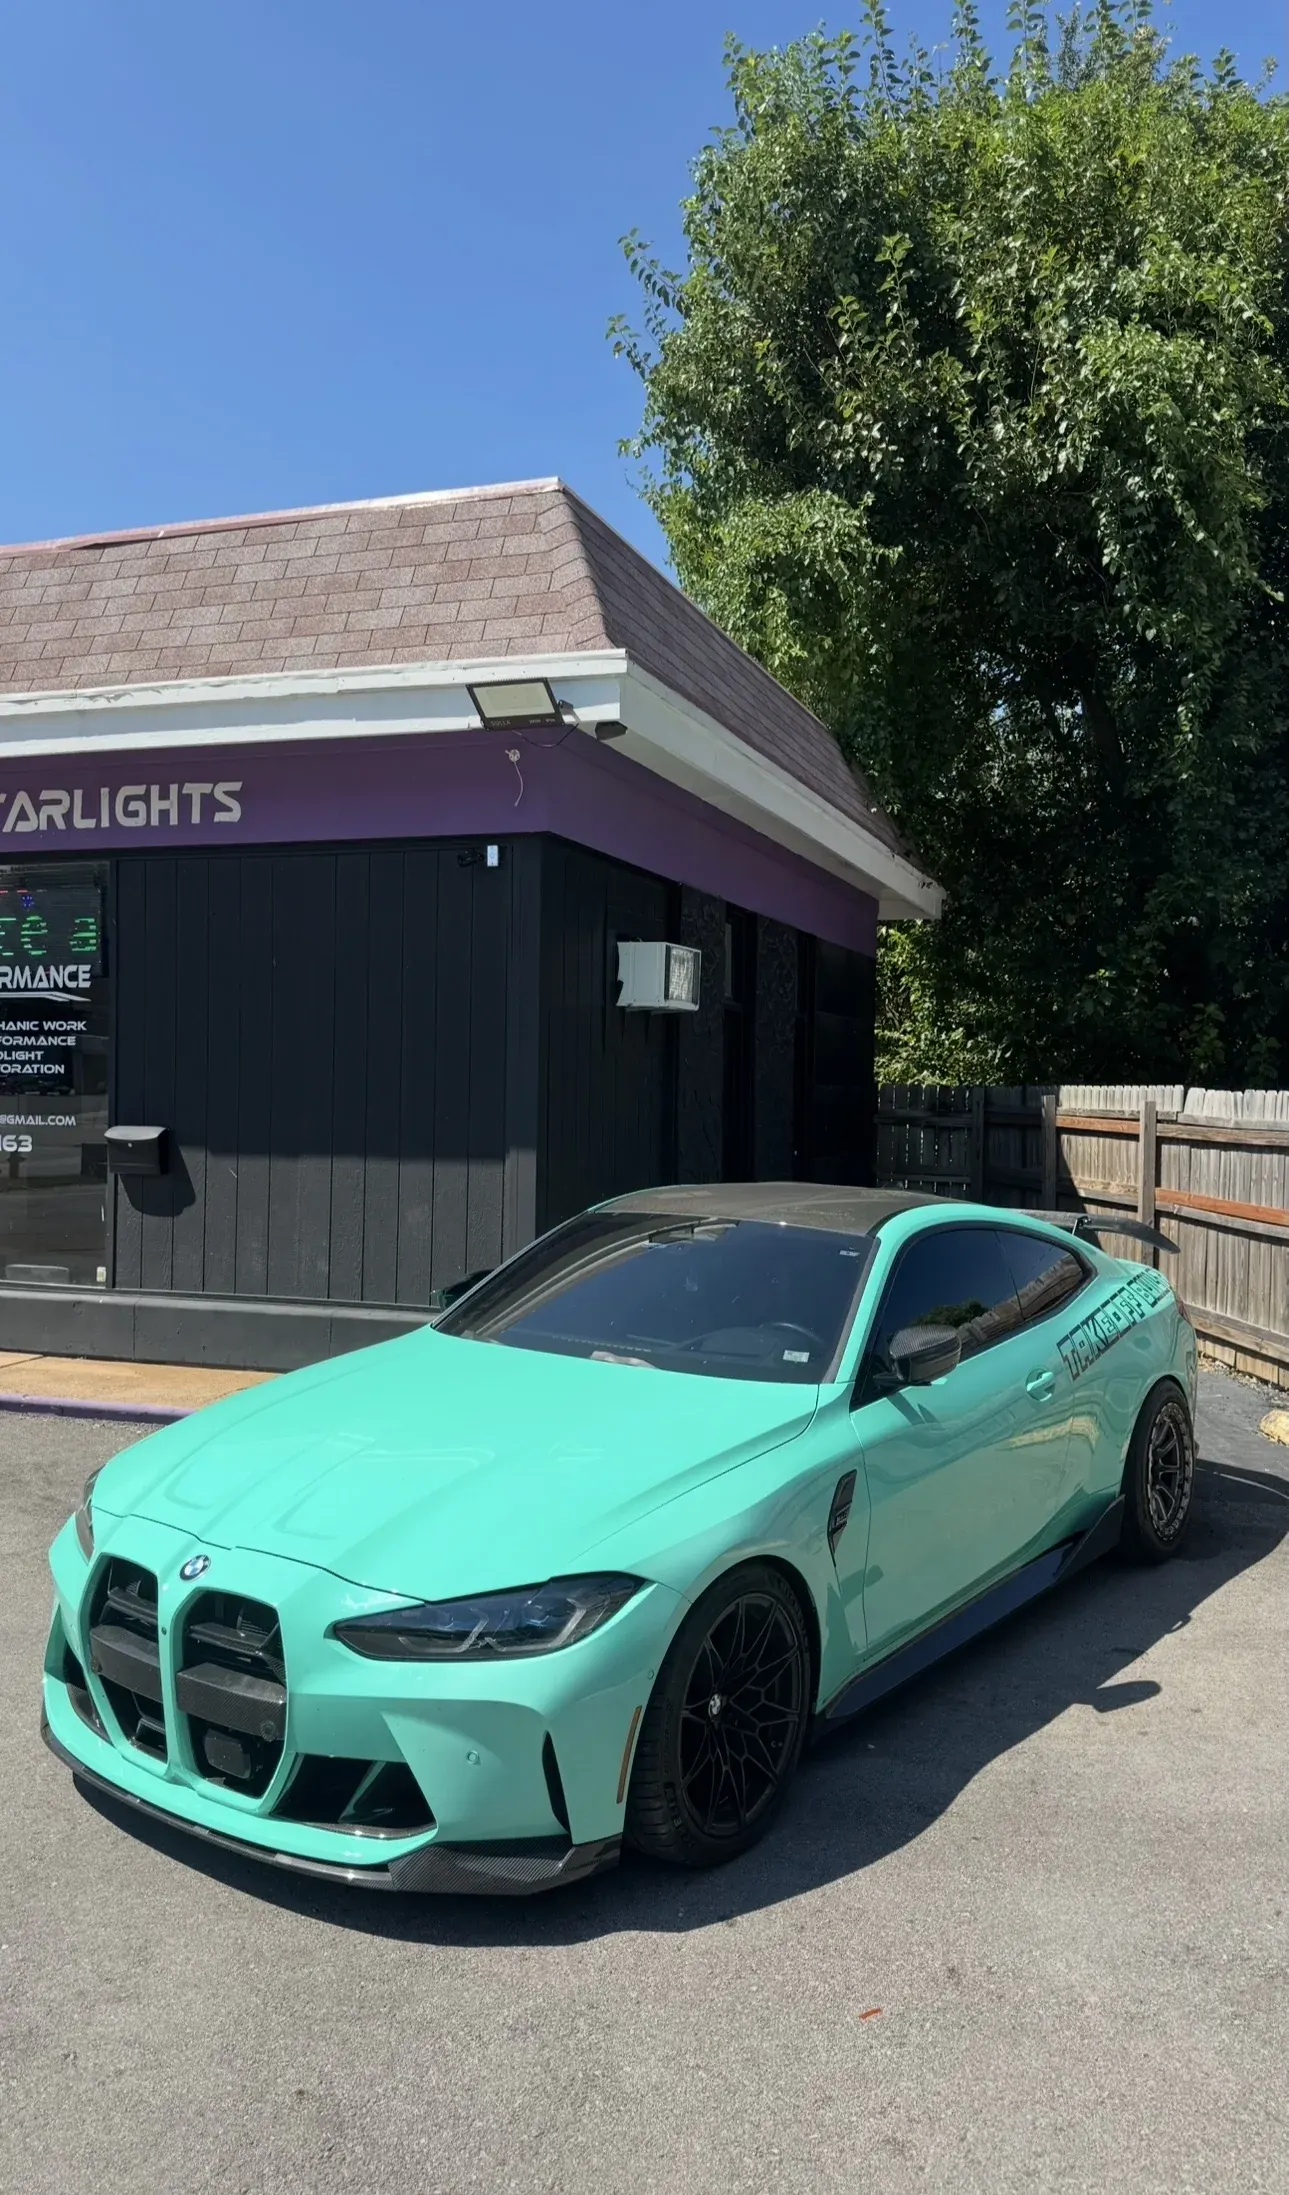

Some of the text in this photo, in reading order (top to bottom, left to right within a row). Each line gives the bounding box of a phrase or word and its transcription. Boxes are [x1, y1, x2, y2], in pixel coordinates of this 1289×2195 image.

[0, 781, 243, 833] ARLIGHTS
[42, 1020, 88, 1031] WORK
[0, 1063, 65, 1074] ORATION
[0, 1134, 33, 1152] 63
[1056, 1286, 1146, 1382] TAKEOFF
